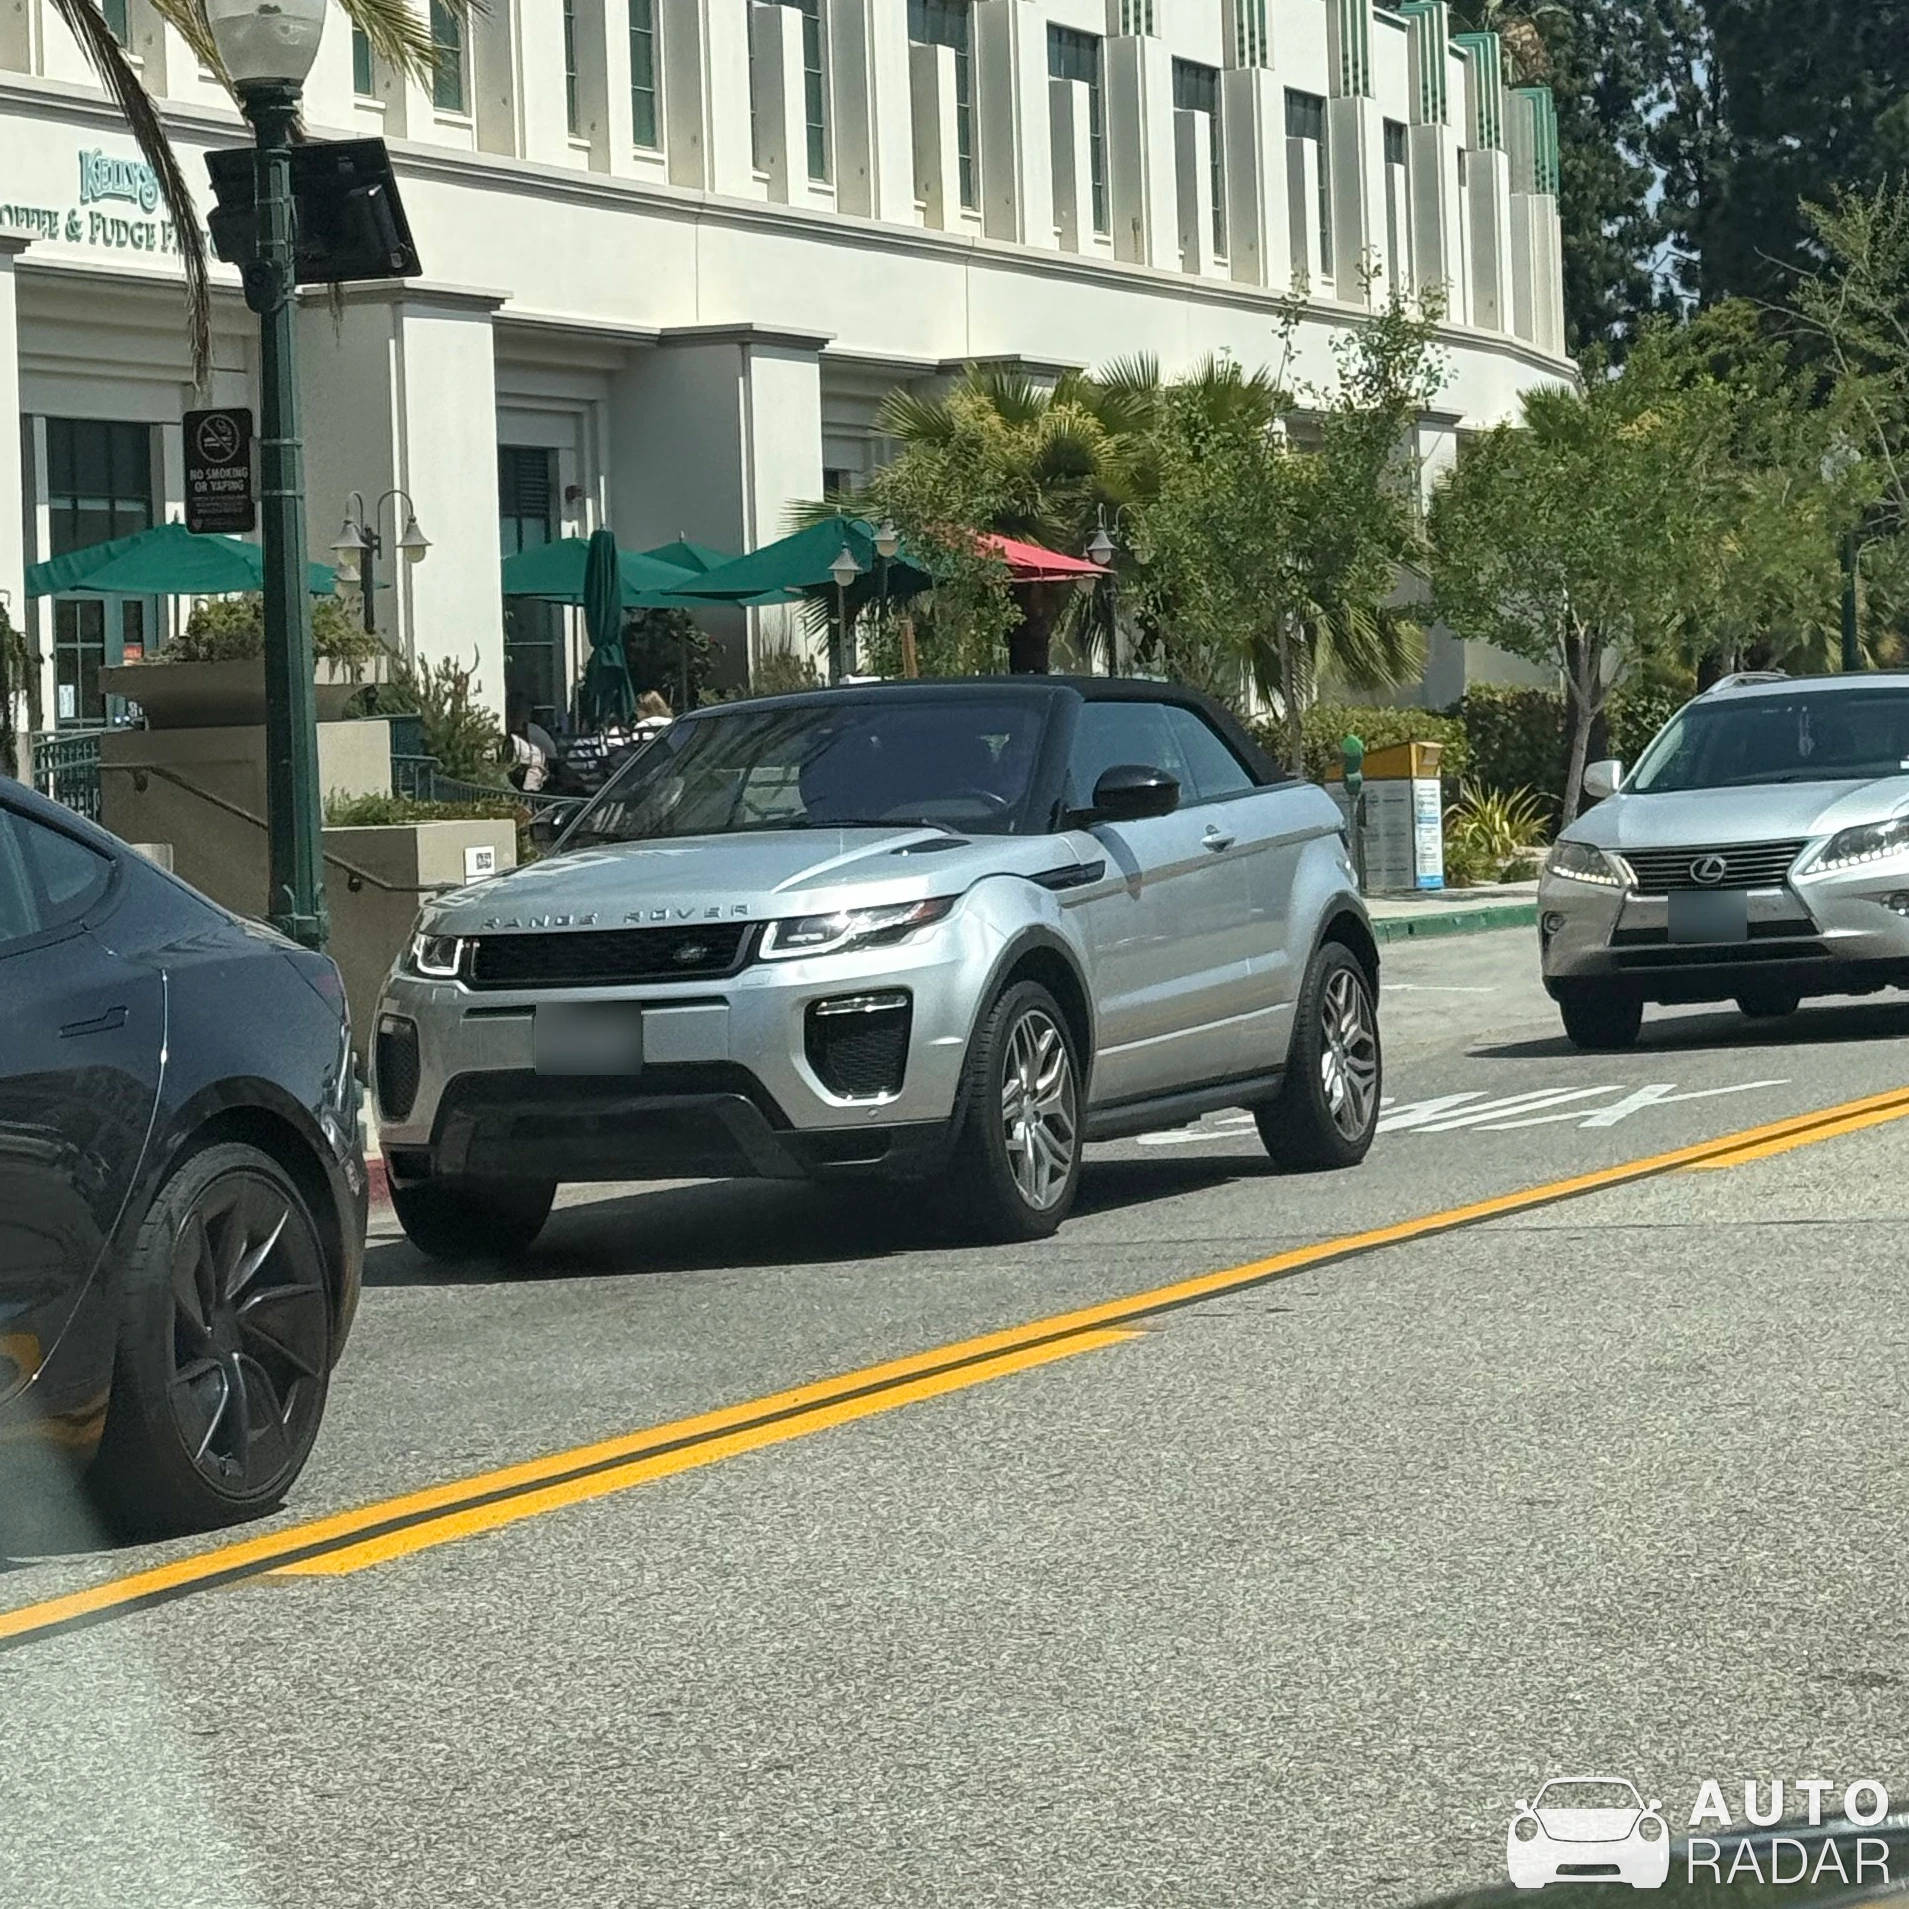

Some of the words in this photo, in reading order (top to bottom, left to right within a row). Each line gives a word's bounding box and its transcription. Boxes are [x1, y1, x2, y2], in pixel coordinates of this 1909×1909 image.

[65, 208, 84, 243] &
[89, 211, 157, 251] FUDGE
[190, 469, 204, 480] NO
[205, 466, 248, 480] SMOKING
[194, 481, 208, 492] OR
[210, 479, 245, 491] VAPING
[481, 913, 599, 929] RANGE
[623, 904, 750, 923] ROVER
